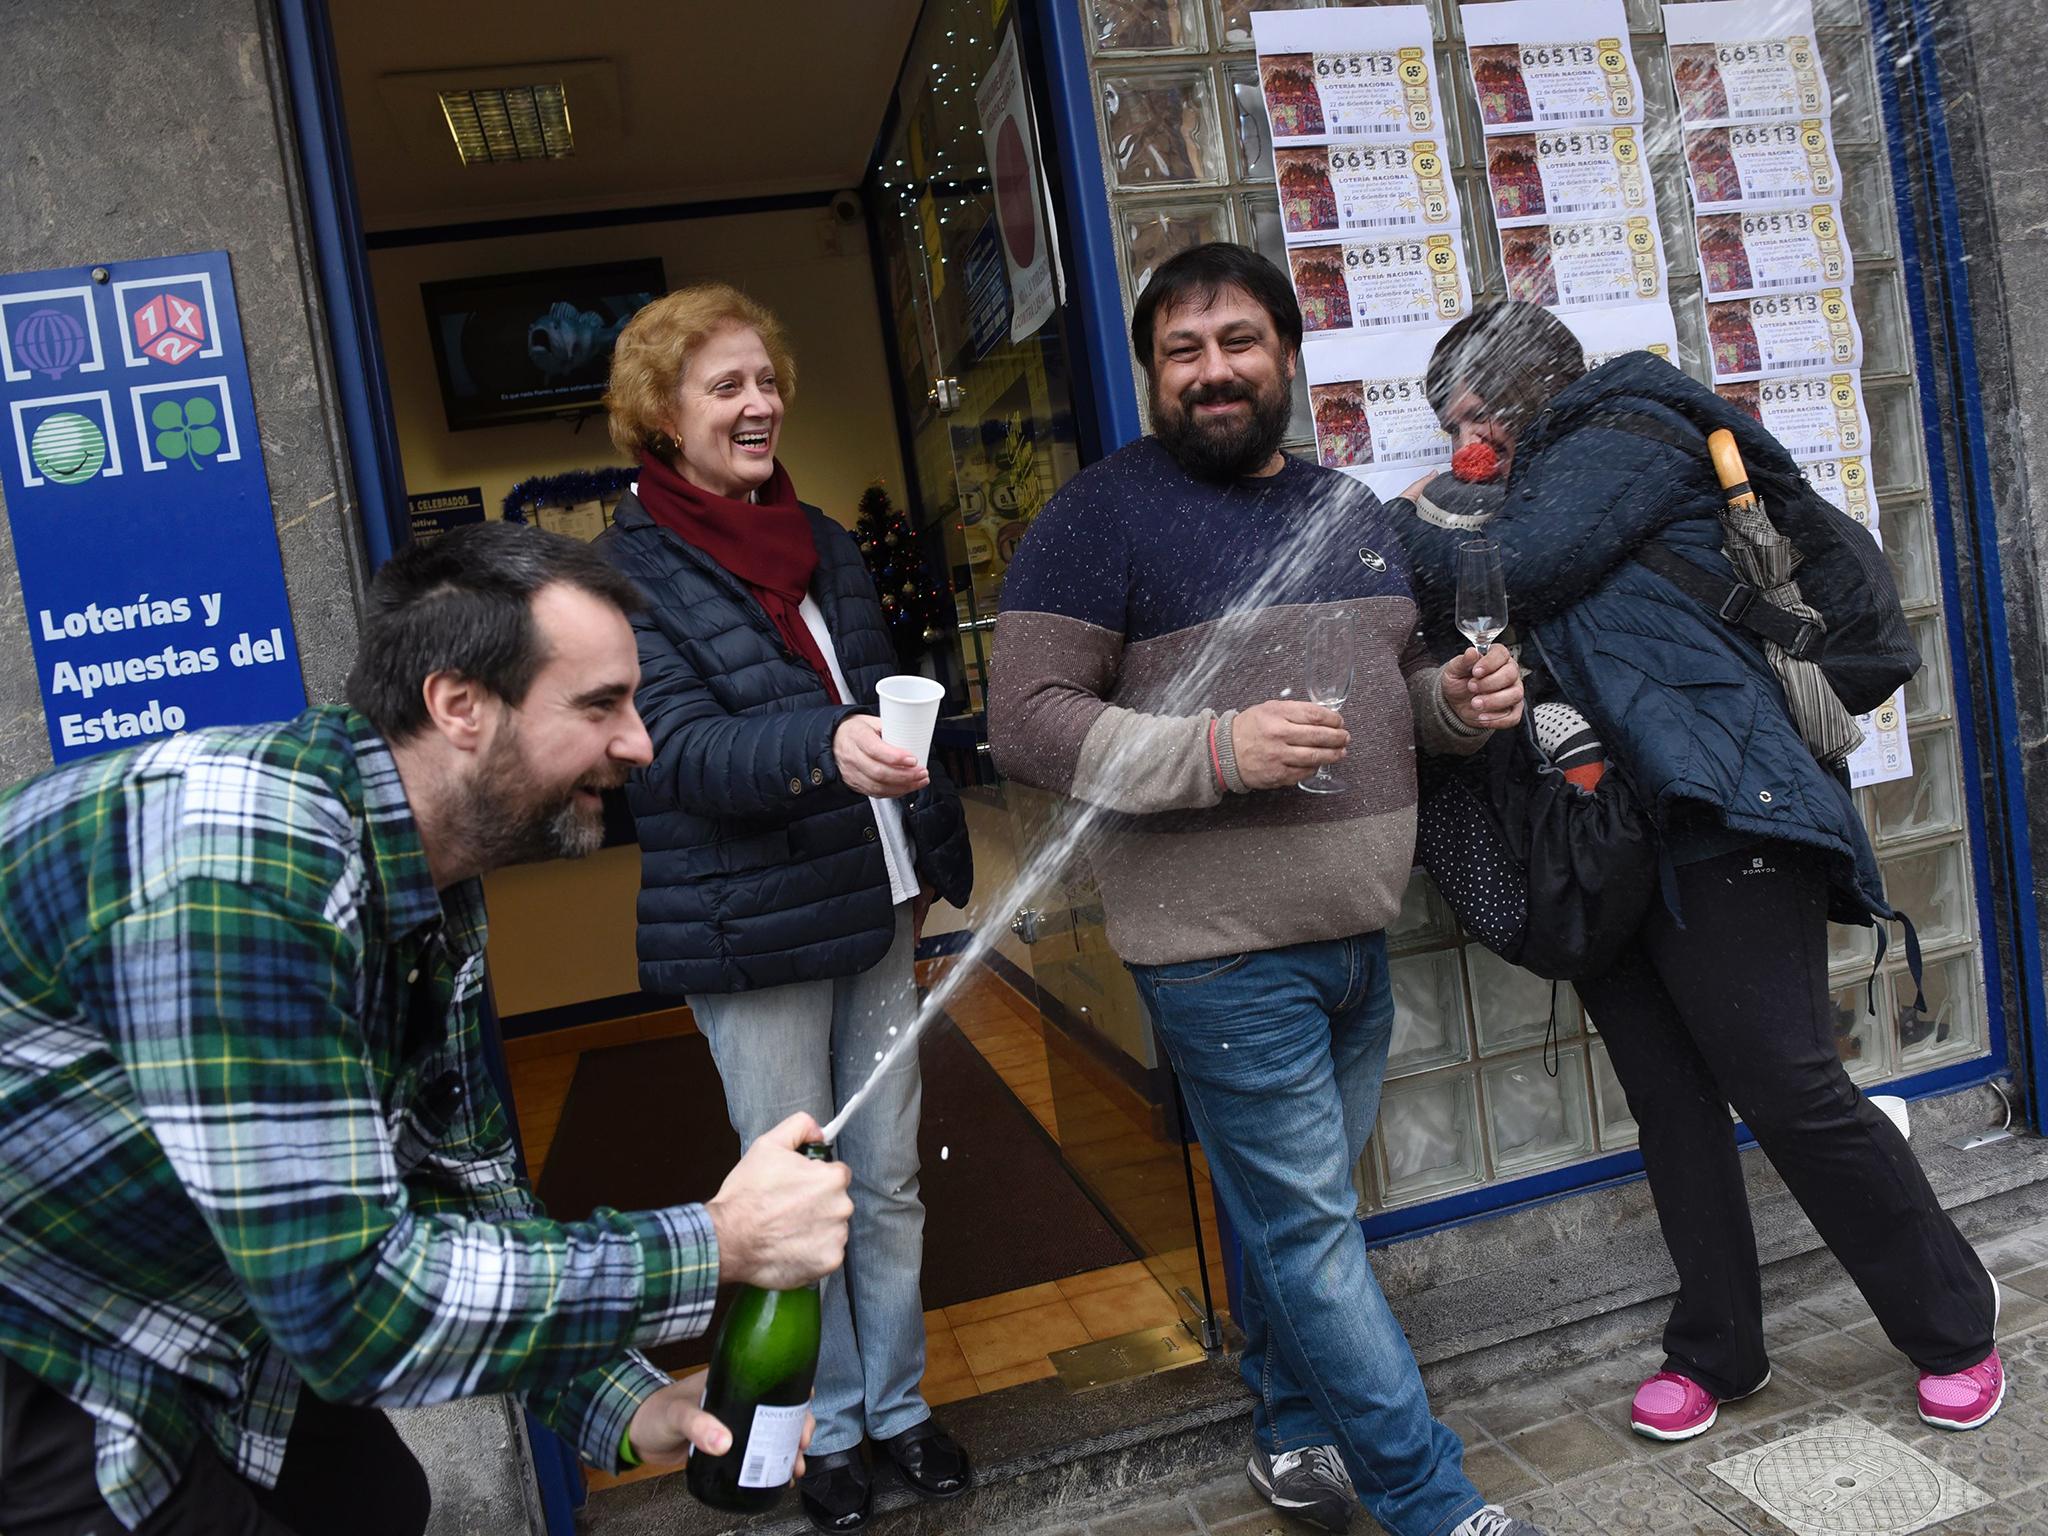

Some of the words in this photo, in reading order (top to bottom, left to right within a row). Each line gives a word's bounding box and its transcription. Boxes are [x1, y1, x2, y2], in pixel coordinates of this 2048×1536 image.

[1523, 48, 1594, 65] 66513
[1720, 45, 1785, 62] 66513
[1318, 58, 1393, 75] 66513
[1616, 97, 1628, 106] 20
[1805, 94, 1815, 103] 20
[1414, 111, 1426, 120] 20
[1732, 128, 1796, 145] 66513
[1540, 137, 1609, 154] 66513
[1332, 151, 1407, 168] 66513
[1817, 176, 1827, 185] 20
[1628, 187, 1638, 197] 20
[1430, 203, 1441, 212] 20
[1744, 215, 1808, 233] 66513
[1346, 246, 1422, 266] 66513
[1828, 262, 1838, 271] 20
[1642, 277, 1652, 287] 20
[1443, 298, 1455, 308] 20
[1753, 297, 1817, 315] 66513
[1838, 345, 1848, 354] 20
[1367, 381, 1426, 402] 6651
[1762, 383, 1826, 401] 66513
[1845, 431, 1855, 441] 20
[418, 495, 469, 511] CELEBRADOS
[1855, 512, 1864, 520] 20
[40, 593, 191, 641] Loterías
[201, 593, 222, 626] y
[51, 645, 219, 697] Apuestas
[230, 628, 285, 665] del
[59, 701, 186, 747] Estado
[1887, 754, 1896, 764] 20
